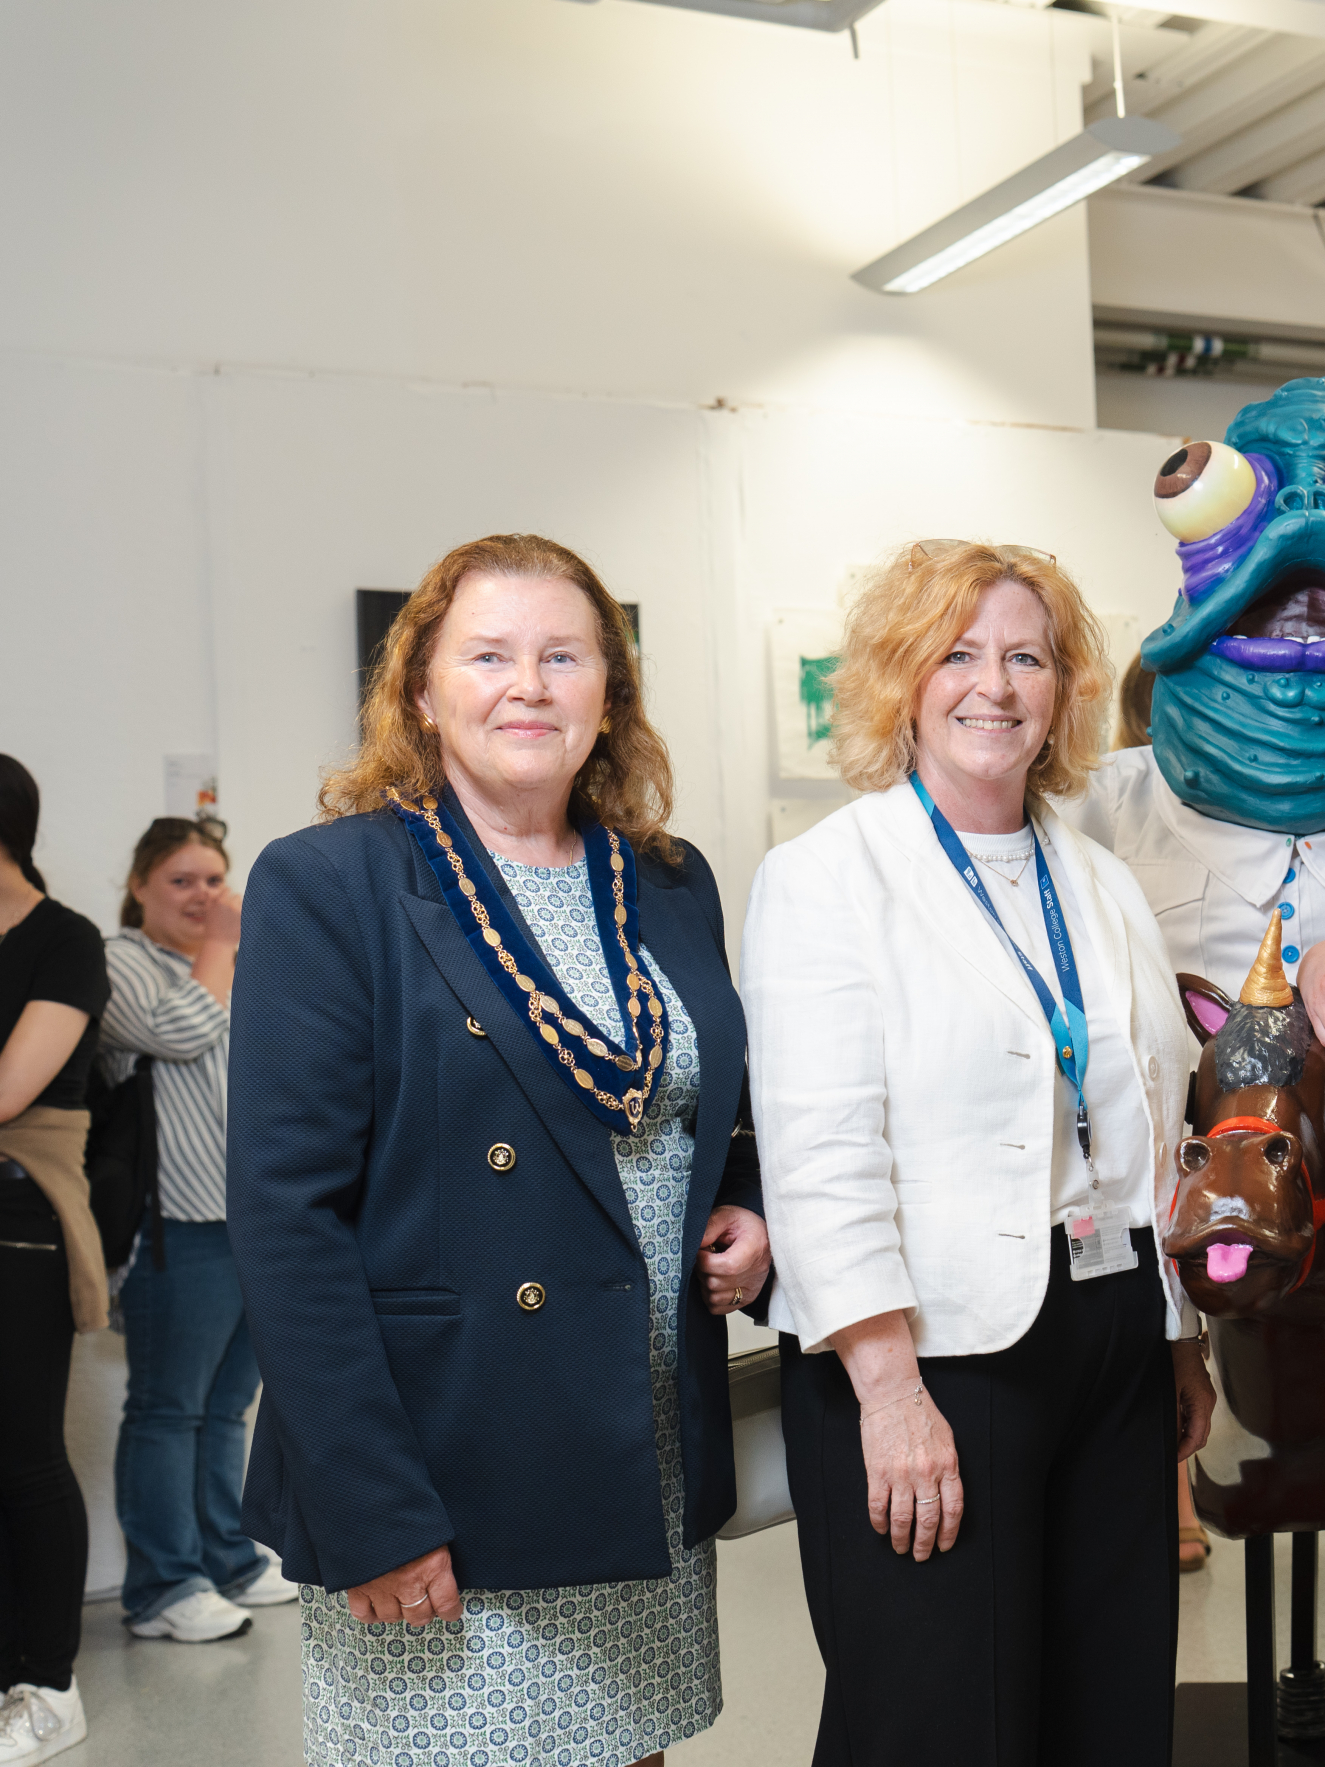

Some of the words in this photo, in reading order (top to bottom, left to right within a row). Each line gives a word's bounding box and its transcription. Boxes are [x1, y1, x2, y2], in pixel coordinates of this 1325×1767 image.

[1043, 888, 1054, 909] Staff
[1049, 908, 1062, 940] College
[1057, 940, 1070, 972] Weston
